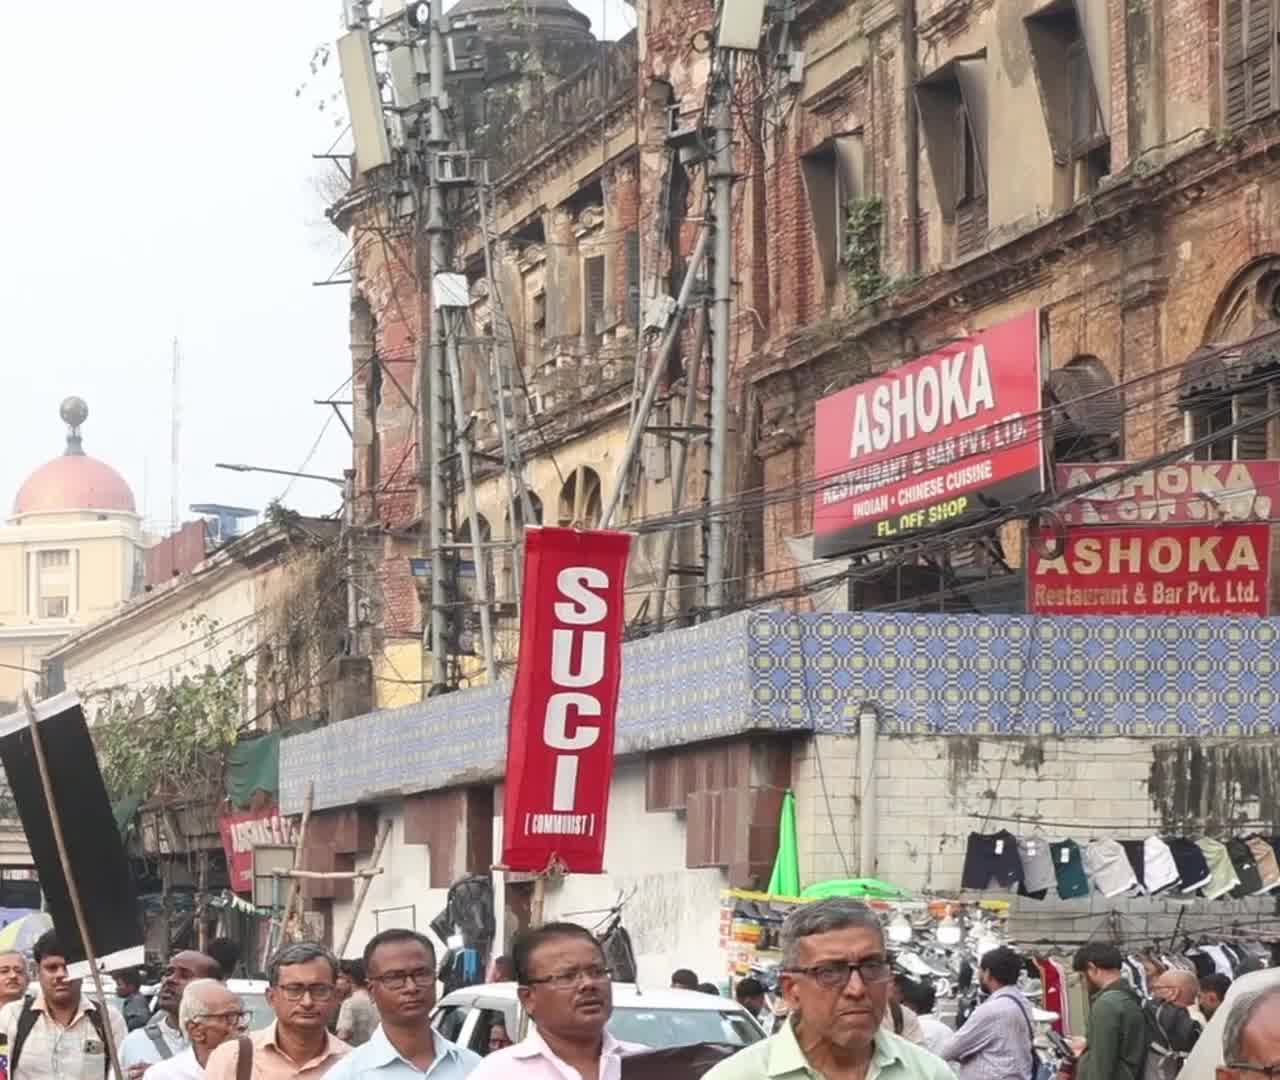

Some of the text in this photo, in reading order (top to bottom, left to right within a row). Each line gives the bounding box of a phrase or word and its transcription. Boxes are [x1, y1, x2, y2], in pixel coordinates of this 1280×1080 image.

[850, 343, 995, 459] ASHOKA
[927, 438, 956, 470] BAR
[853, 460, 993, 520] INDIAN CHINESE CUISINE
[928, 496, 968, 523] SHOP
[1036, 535, 1260, 575] ASHOKA
[1035, 580, 1260, 607] Restaurant & Bar Pvt. Ltd.
[542, 566, 609, 812] SUCI
